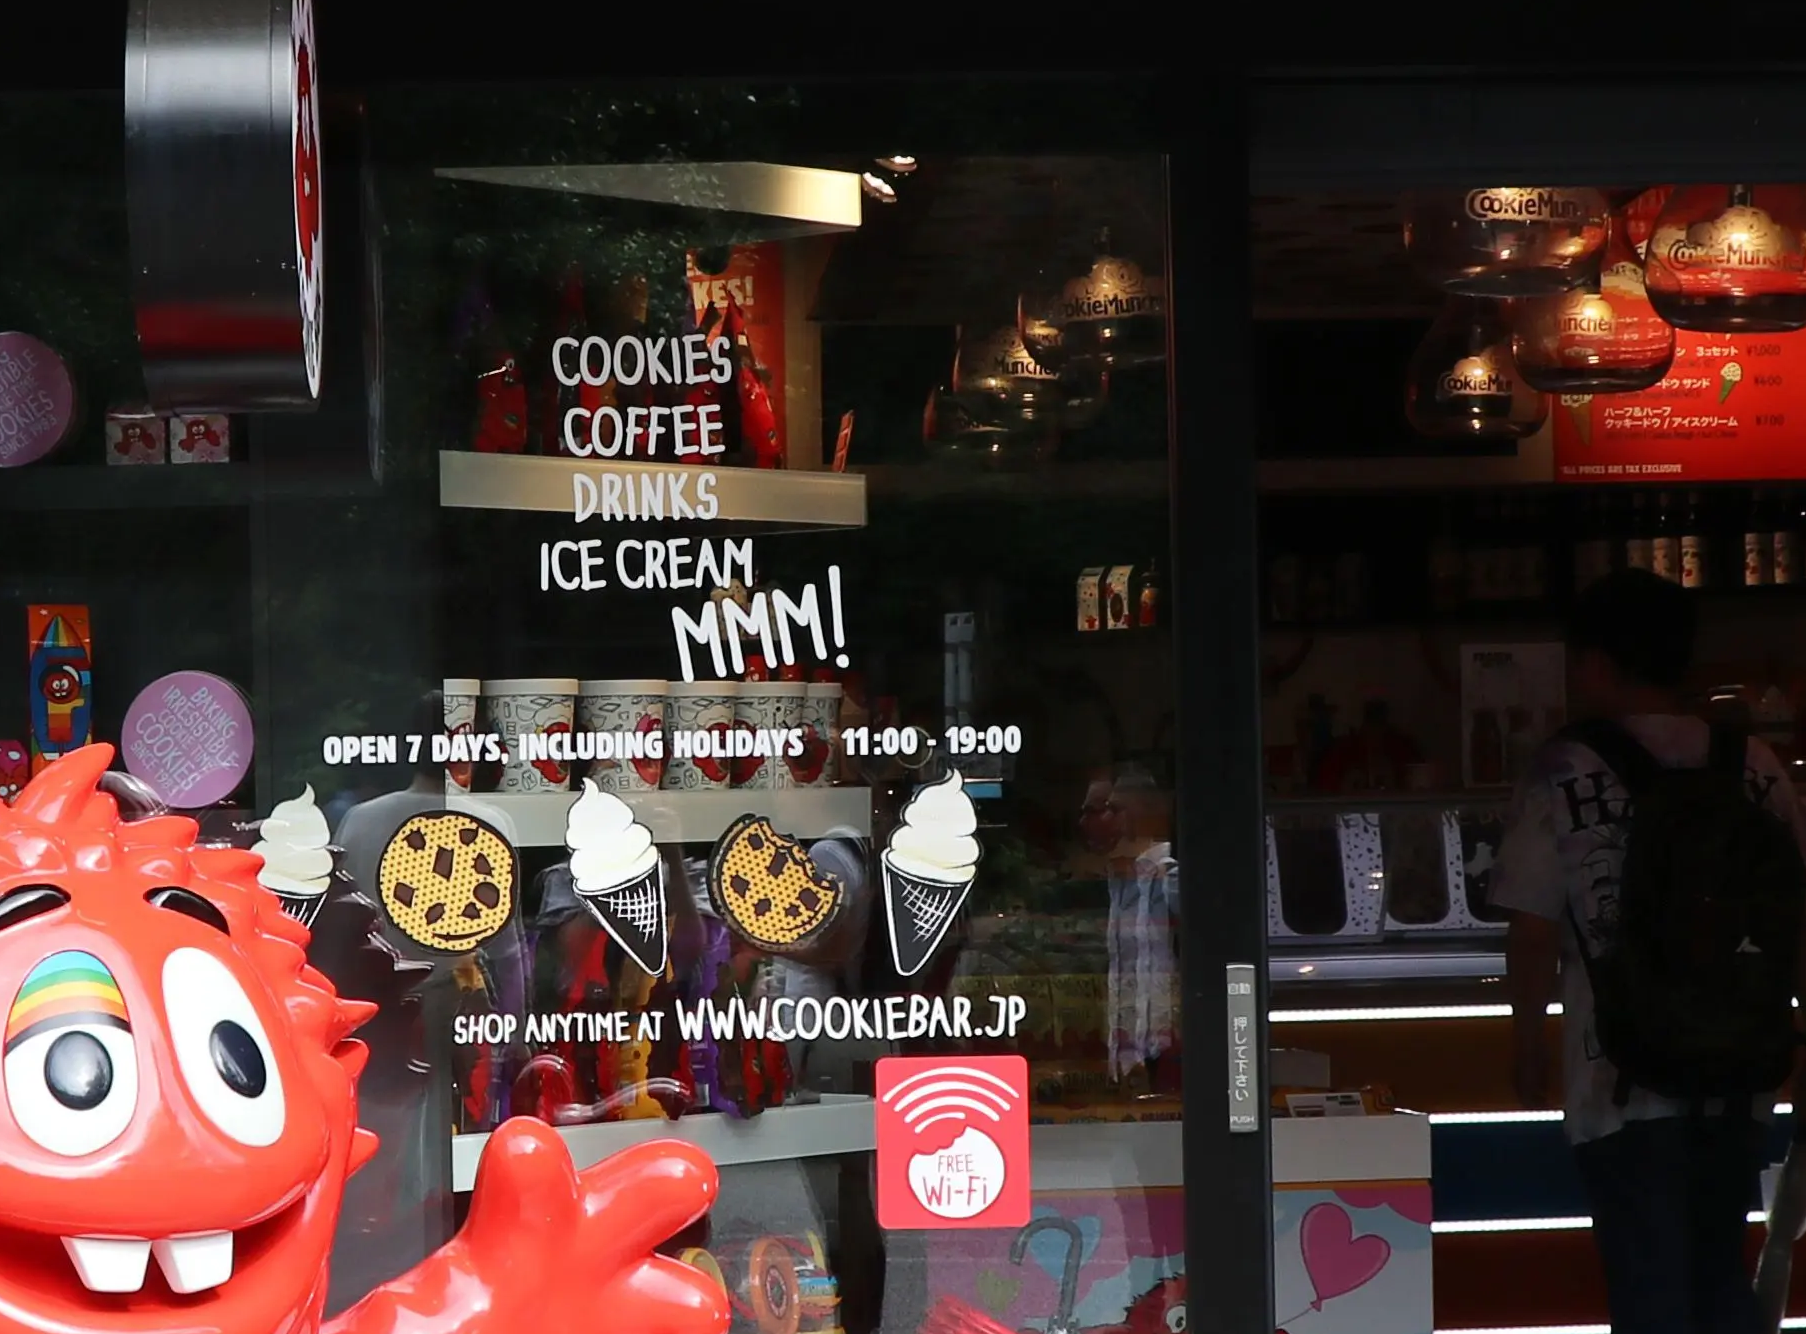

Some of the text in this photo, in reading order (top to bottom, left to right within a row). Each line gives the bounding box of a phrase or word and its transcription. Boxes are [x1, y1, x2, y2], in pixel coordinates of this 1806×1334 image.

[551, 334, 734, 388] COOKIES
[564, 403, 725, 459] COFFEE
[1672, 416, 1739, 428] アイスクリーム
[574, 471, 719, 524] DRINKS
[540, 536, 754, 591] ICE CREAM
[671, 564, 850, 683] MMM!
[161, 684, 240, 770] IRRESISTIBLE
[189, 686, 239, 739] BAKING
[130, 739, 160, 772] SINCE
[135, 713, 202, 791] COOKIES
[323, 736, 401, 766] OPEN
[405, 736, 424, 764] 7
[432, 733, 510, 766] DAYS,
[517, 729, 665, 762] INCLUDING
[672, 727, 804, 759] HOLIDAYS
[843, 725, 919, 757] 11:00
[946, 724, 1023, 755] 19:00
[453, 993, 1027, 1046] SHOP ANYTIME AT WWW.COOKIEBAR.JP
[1234, 1016, 1248, 1101] 押して下さい
[1230, 1115, 1255, 1124] PUSH
[938, 1153, 975, 1173] FREE
[922, 1176, 988, 1207] Wi-Fi
